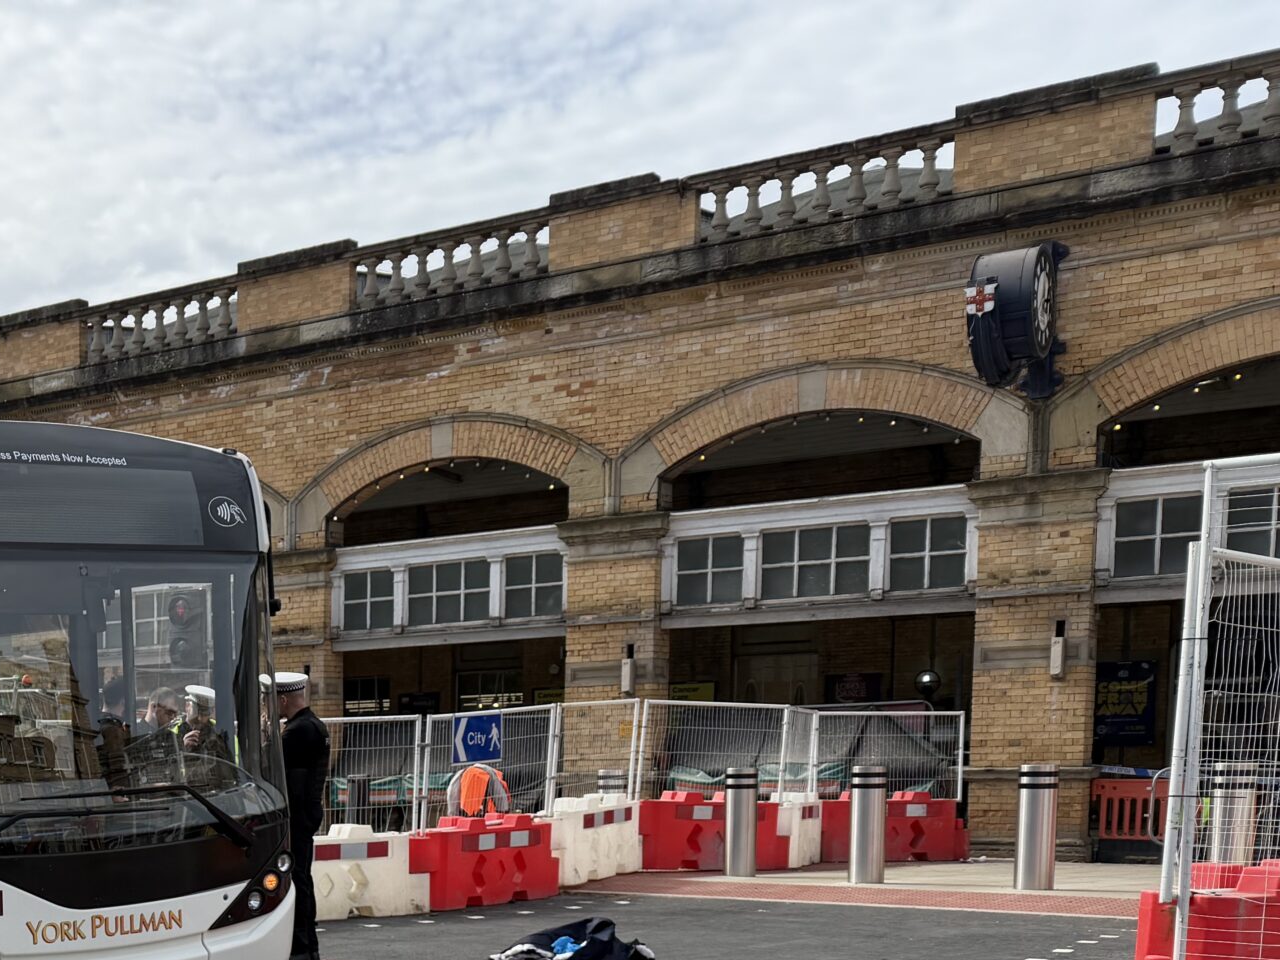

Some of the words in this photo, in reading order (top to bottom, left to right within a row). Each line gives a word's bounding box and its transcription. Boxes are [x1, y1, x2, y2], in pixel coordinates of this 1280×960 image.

[13, 450, 61, 463] Payments
[62, 453, 83, 463] Now
[85, 455, 127, 467] Accepted
[467, 731, 487, 746] City
[26, 919, 86, 945] YORK
[91, 909, 183, 939] PULLMAN
